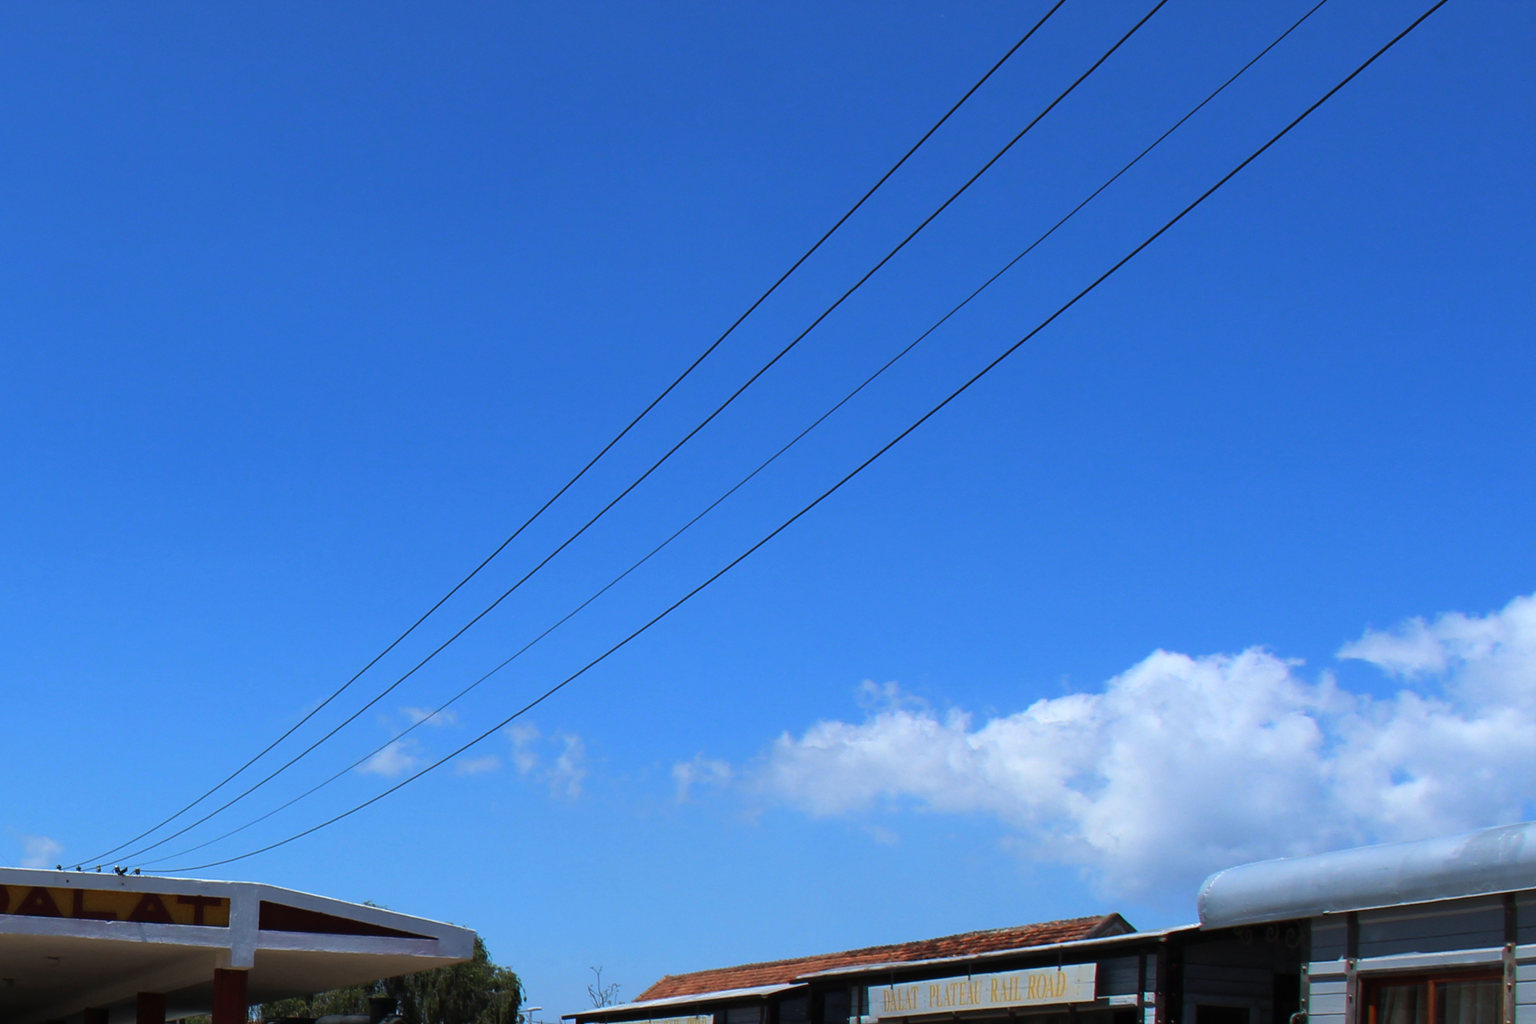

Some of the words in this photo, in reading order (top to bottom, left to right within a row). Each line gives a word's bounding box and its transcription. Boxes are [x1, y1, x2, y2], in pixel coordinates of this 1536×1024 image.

[884, 986, 919, 1012] DALAT
[929, 980, 984, 1008] PLATEAU
[990, 975, 1022, 1003] RAIL
[1027, 971, 1067, 1001] ROAD
